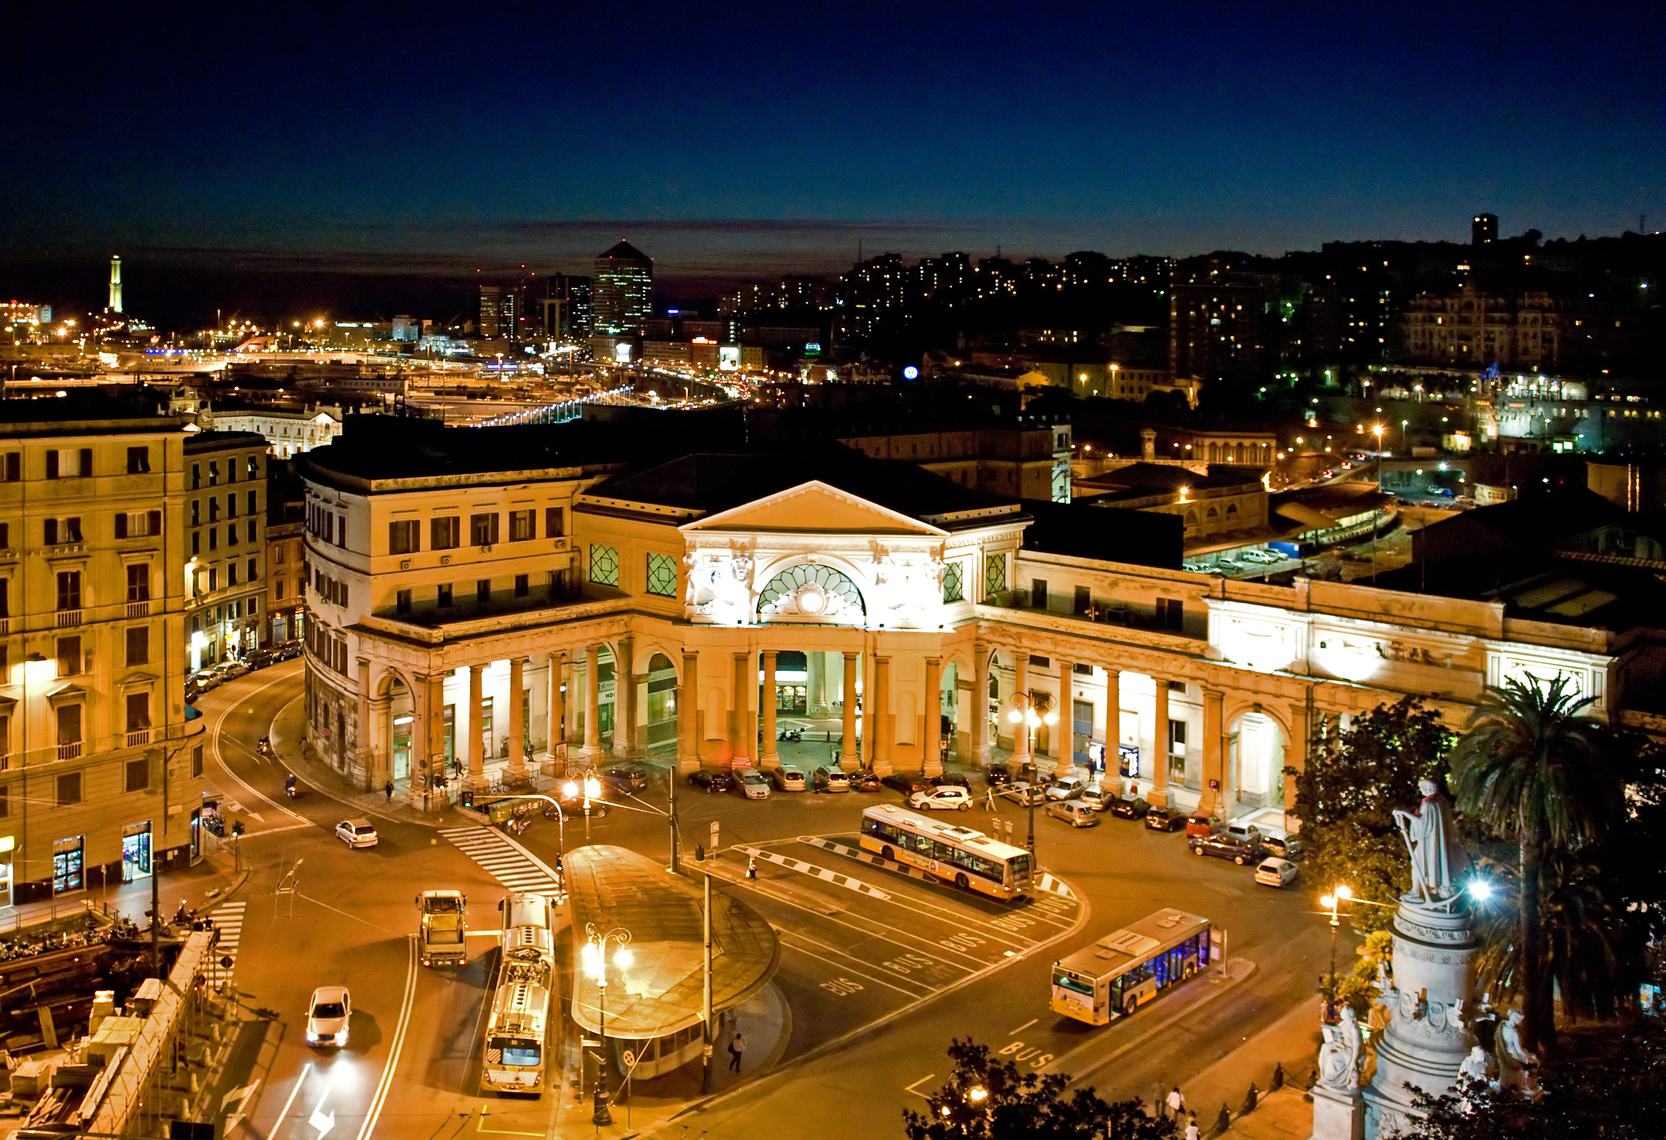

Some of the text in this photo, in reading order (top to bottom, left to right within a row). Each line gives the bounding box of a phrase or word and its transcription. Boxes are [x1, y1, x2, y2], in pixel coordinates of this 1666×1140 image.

[1033, 896, 1077, 913] BUS
[990, 915, 1036, 931] BUS
[940, 933, 986, 952] BUS
[882, 953, 933, 974] BUS
[820, 977, 864, 997] BUS
[999, 1041, 1054, 1068] BUS
